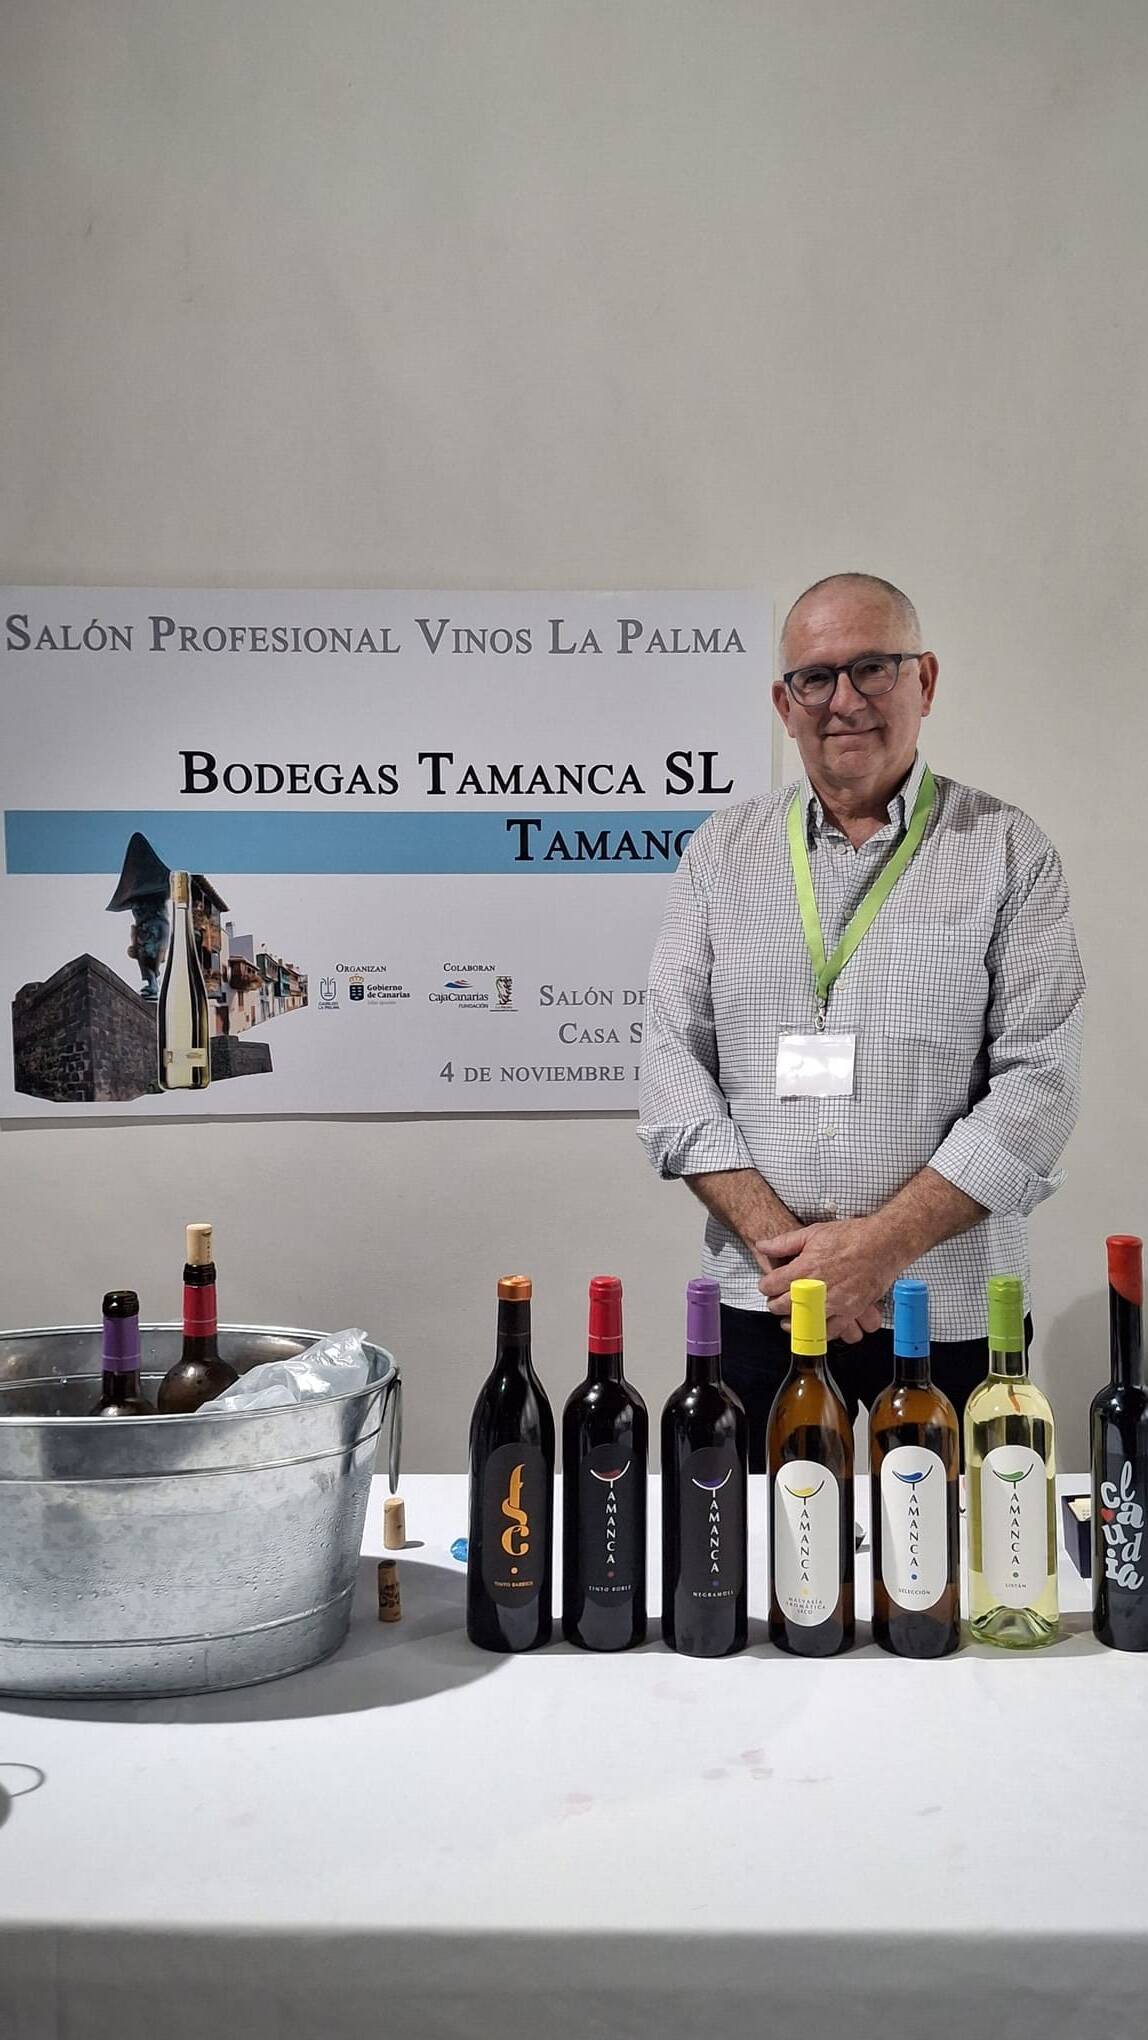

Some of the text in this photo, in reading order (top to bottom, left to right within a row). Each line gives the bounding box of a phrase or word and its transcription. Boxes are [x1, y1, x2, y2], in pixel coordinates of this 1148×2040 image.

[5, 613, 747, 654] SALÓN PROFESIONAL VINOS LA PALMA
[179, 750, 735, 795] BODEGAS TAMANCA SL
[335, 963, 387, 973] ORGANIZAN
[443, 962, 496, 972] COLABORAN
[366, 991, 411, 999] de Canarias
[428, 992, 489, 1004] CajaCanarias
[539, 984, 614, 1007] SALÓN
[558, 1022, 621, 1044] CASA
[440, 1061, 455, 1083] 4
[464, 1067, 492, 1082] DE
[500, 1066, 625, 1082] NOVIEMBRE
